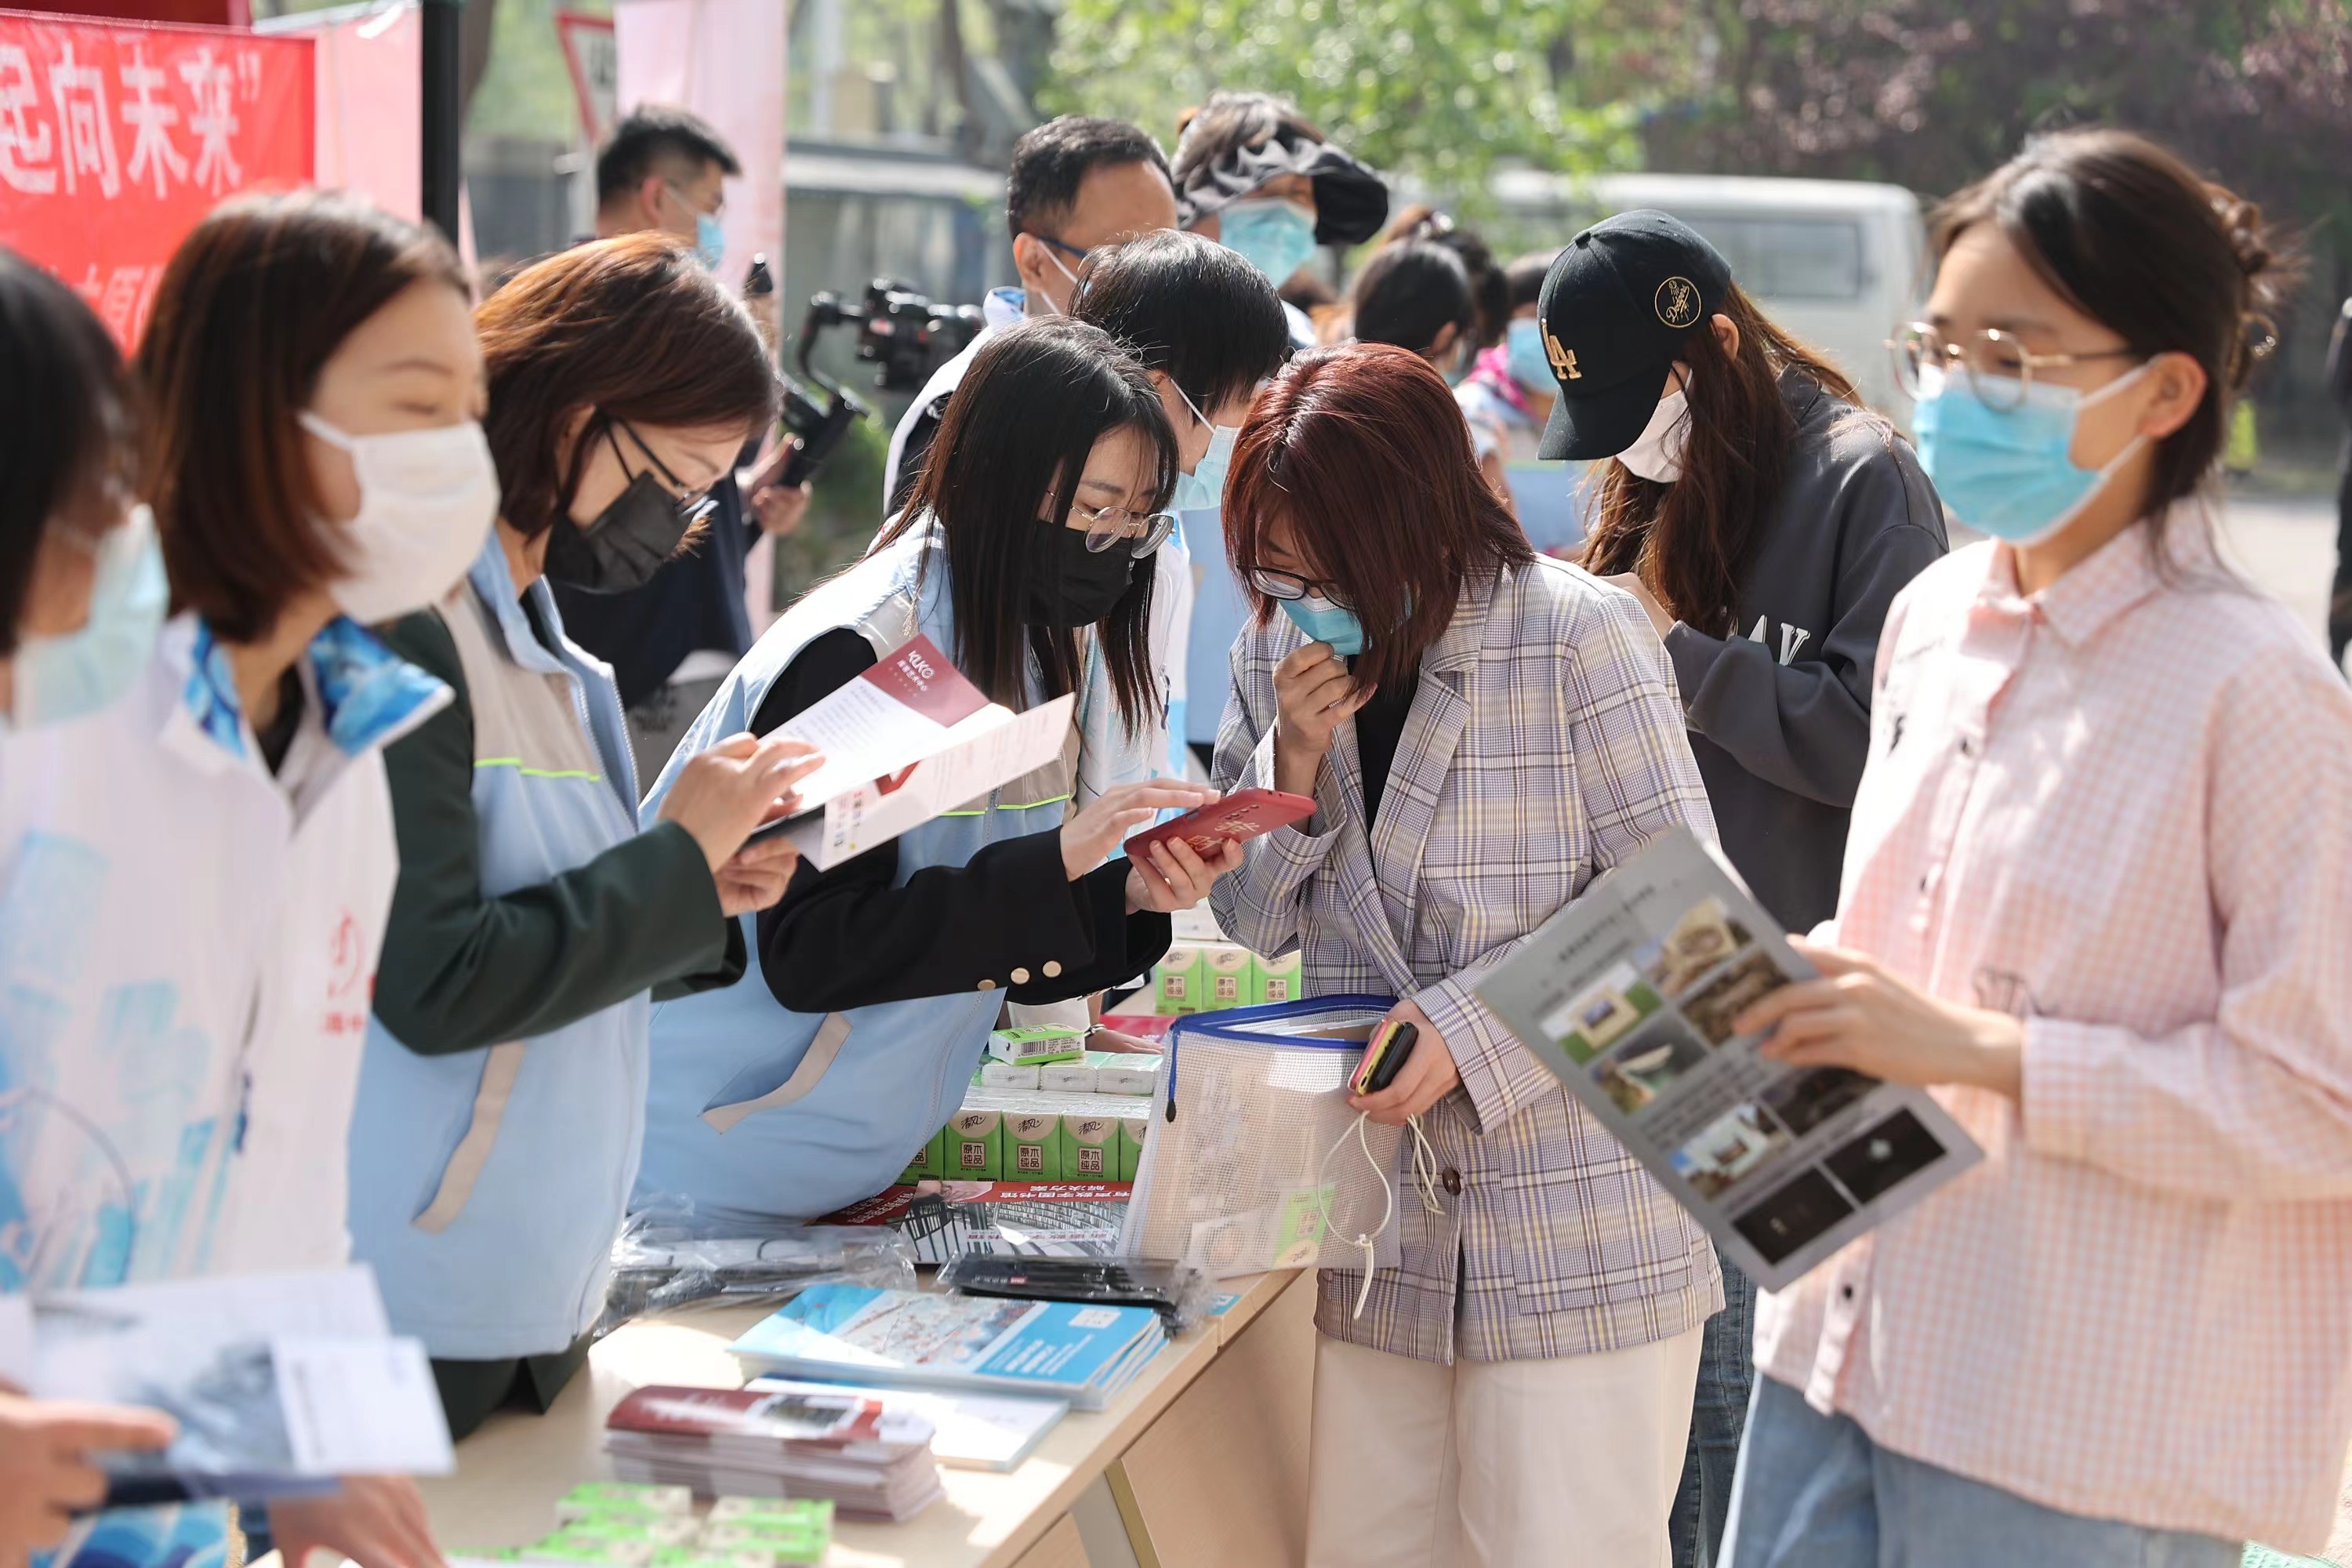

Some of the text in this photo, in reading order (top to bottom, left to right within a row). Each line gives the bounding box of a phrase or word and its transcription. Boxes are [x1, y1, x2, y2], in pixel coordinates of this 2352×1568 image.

[1541, 318, 1582, 379] LA
[961, 1116, 986, 1129] 清风
[1018, 1118, 1044, 1132] 清风
[1078, 1121, 1104, 1135] 清风
[964, 1145, 982, 1154] 原木
[1020, 1148, 1040, 1157] 原木
[964, 1155, 982, 1164] 纯品
[1080, 1150, 1100, 1160] 原木
[1020, 1158, 1040, 1167] 纯品
[1080, 1160, 1100, 1170] 纯品
